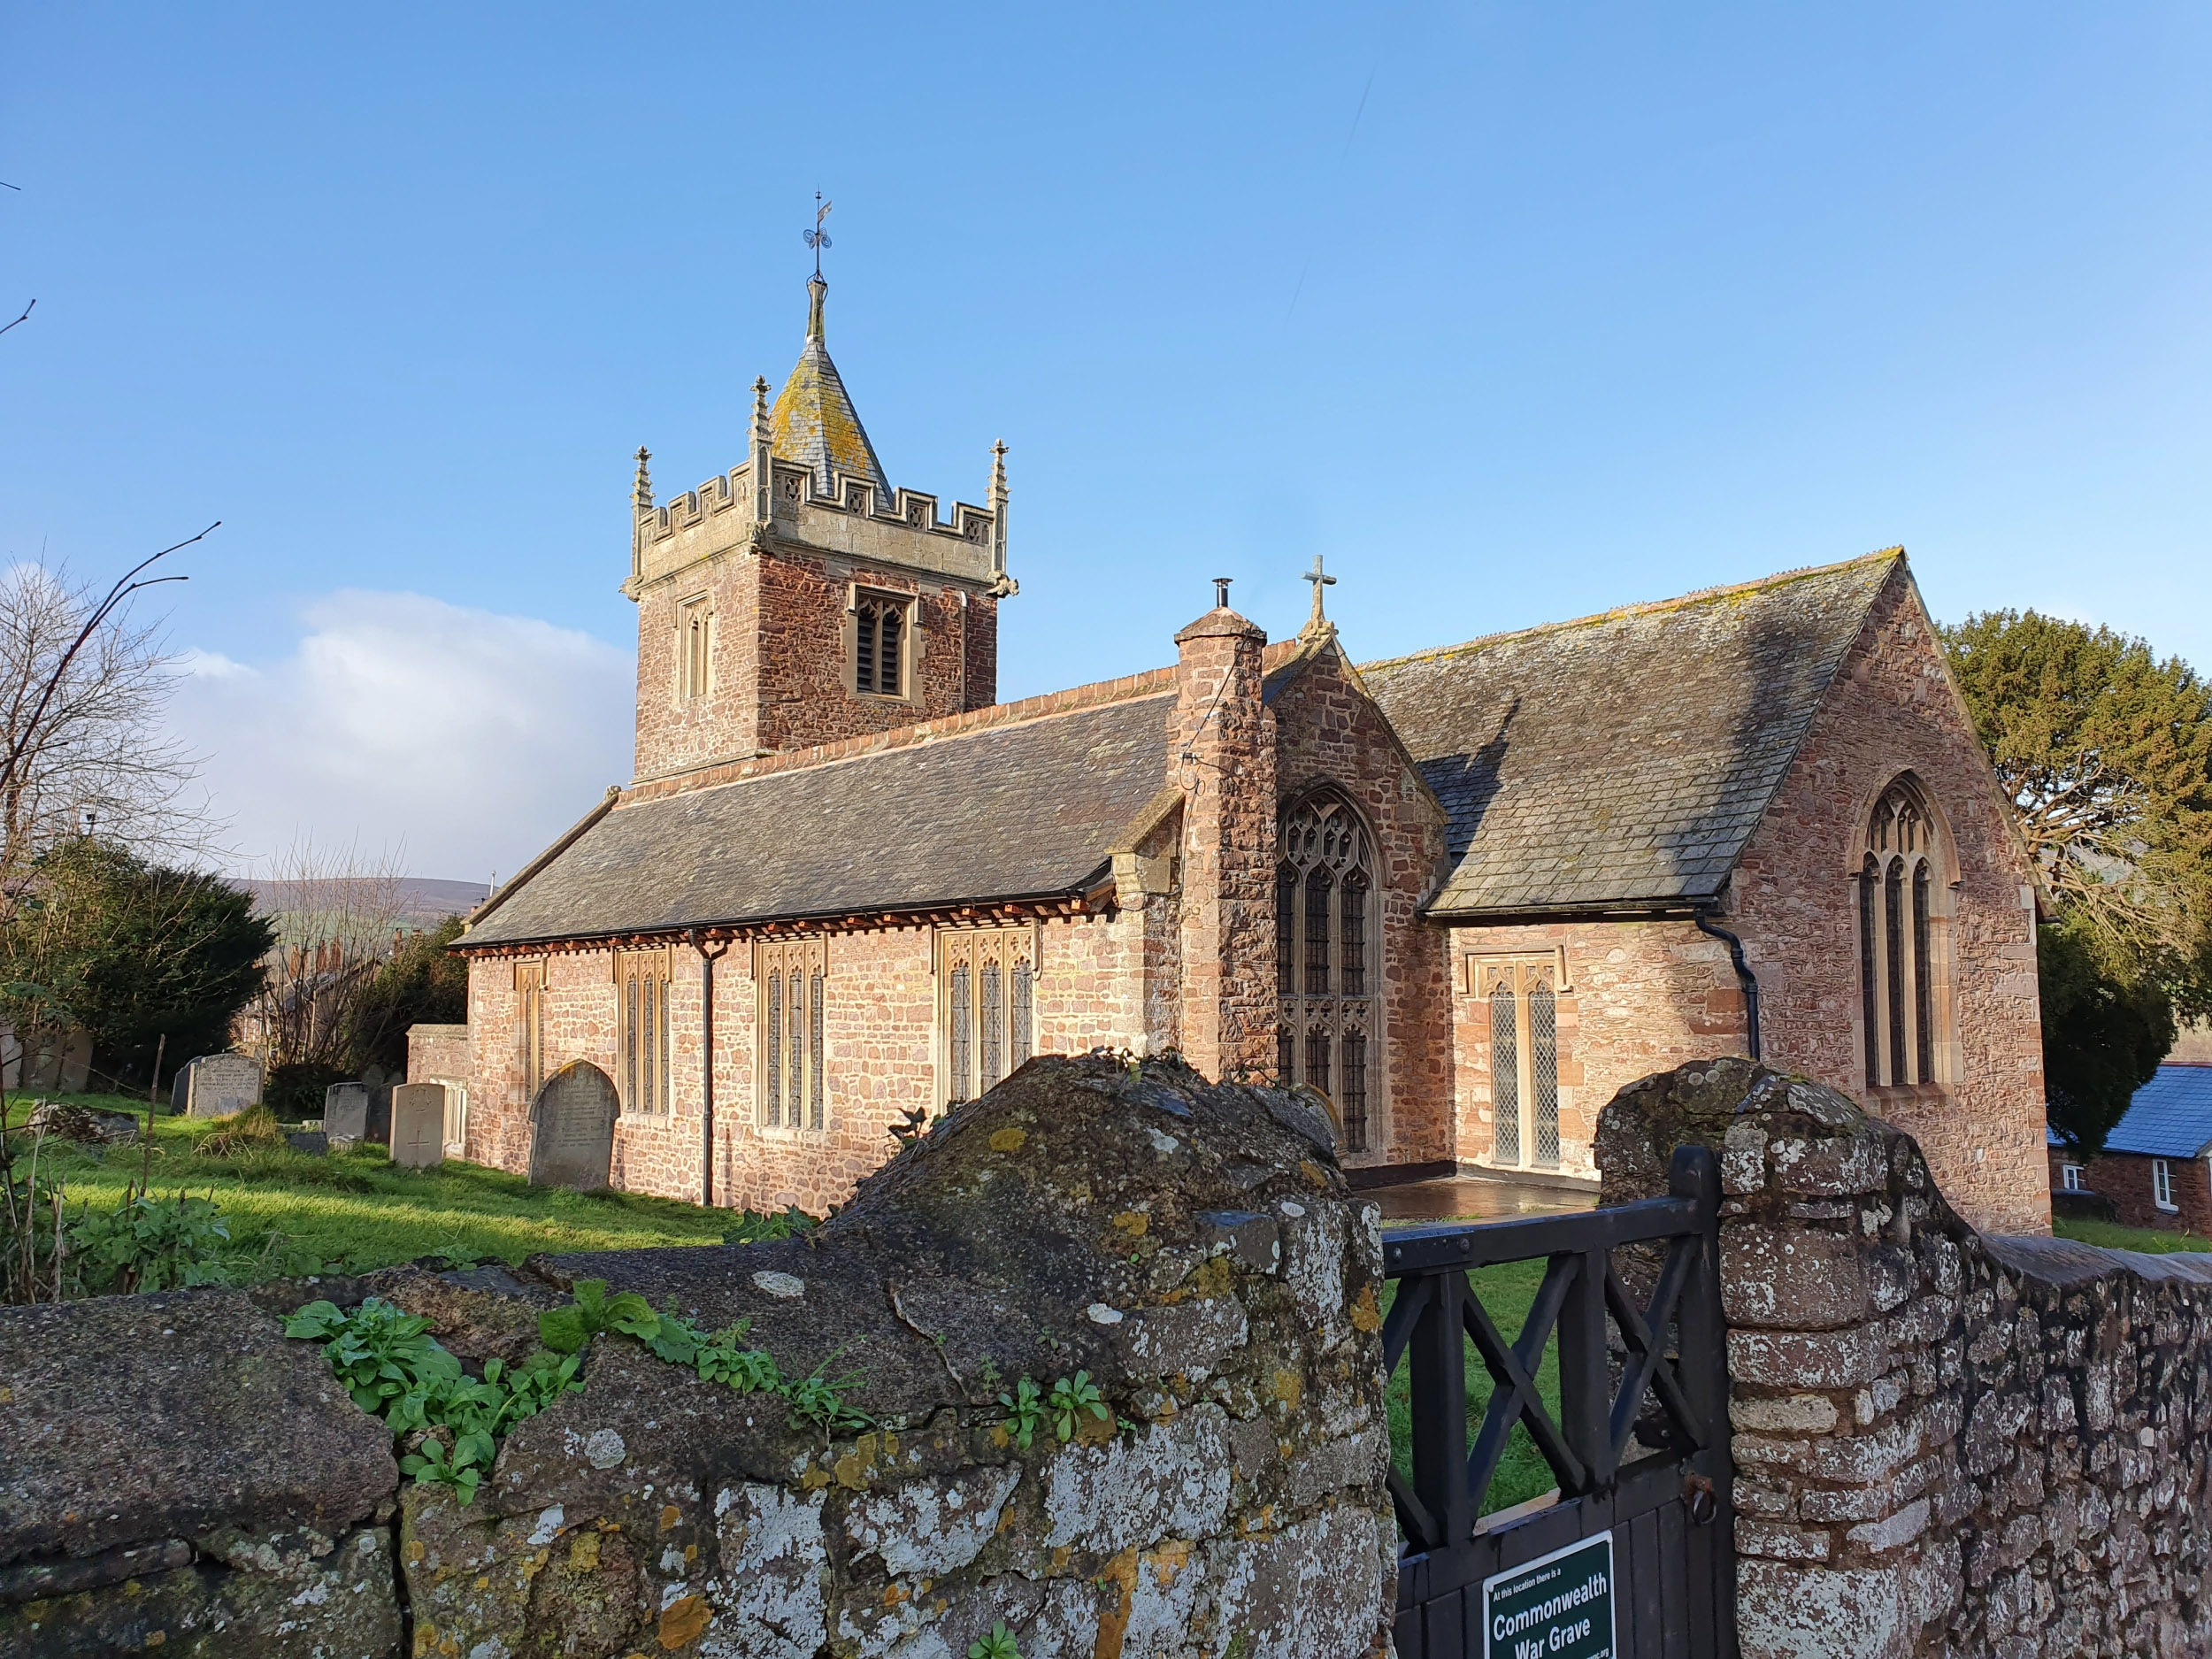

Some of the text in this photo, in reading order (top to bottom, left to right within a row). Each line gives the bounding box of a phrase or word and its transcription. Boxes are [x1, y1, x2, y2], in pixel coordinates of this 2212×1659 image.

[1494, 1592, 1501, 1602] At
[1502, 1586, 1512, 1599] this
[1513, 1578, 1535, 1594] location
[1536, 1573, 1550, 1584] there
[1551, 1568, 1556, 1578] is
[1494, 1572, 1607, 1640] Commonwealth
[1515, 1618, 1590, 1659] War Grave
